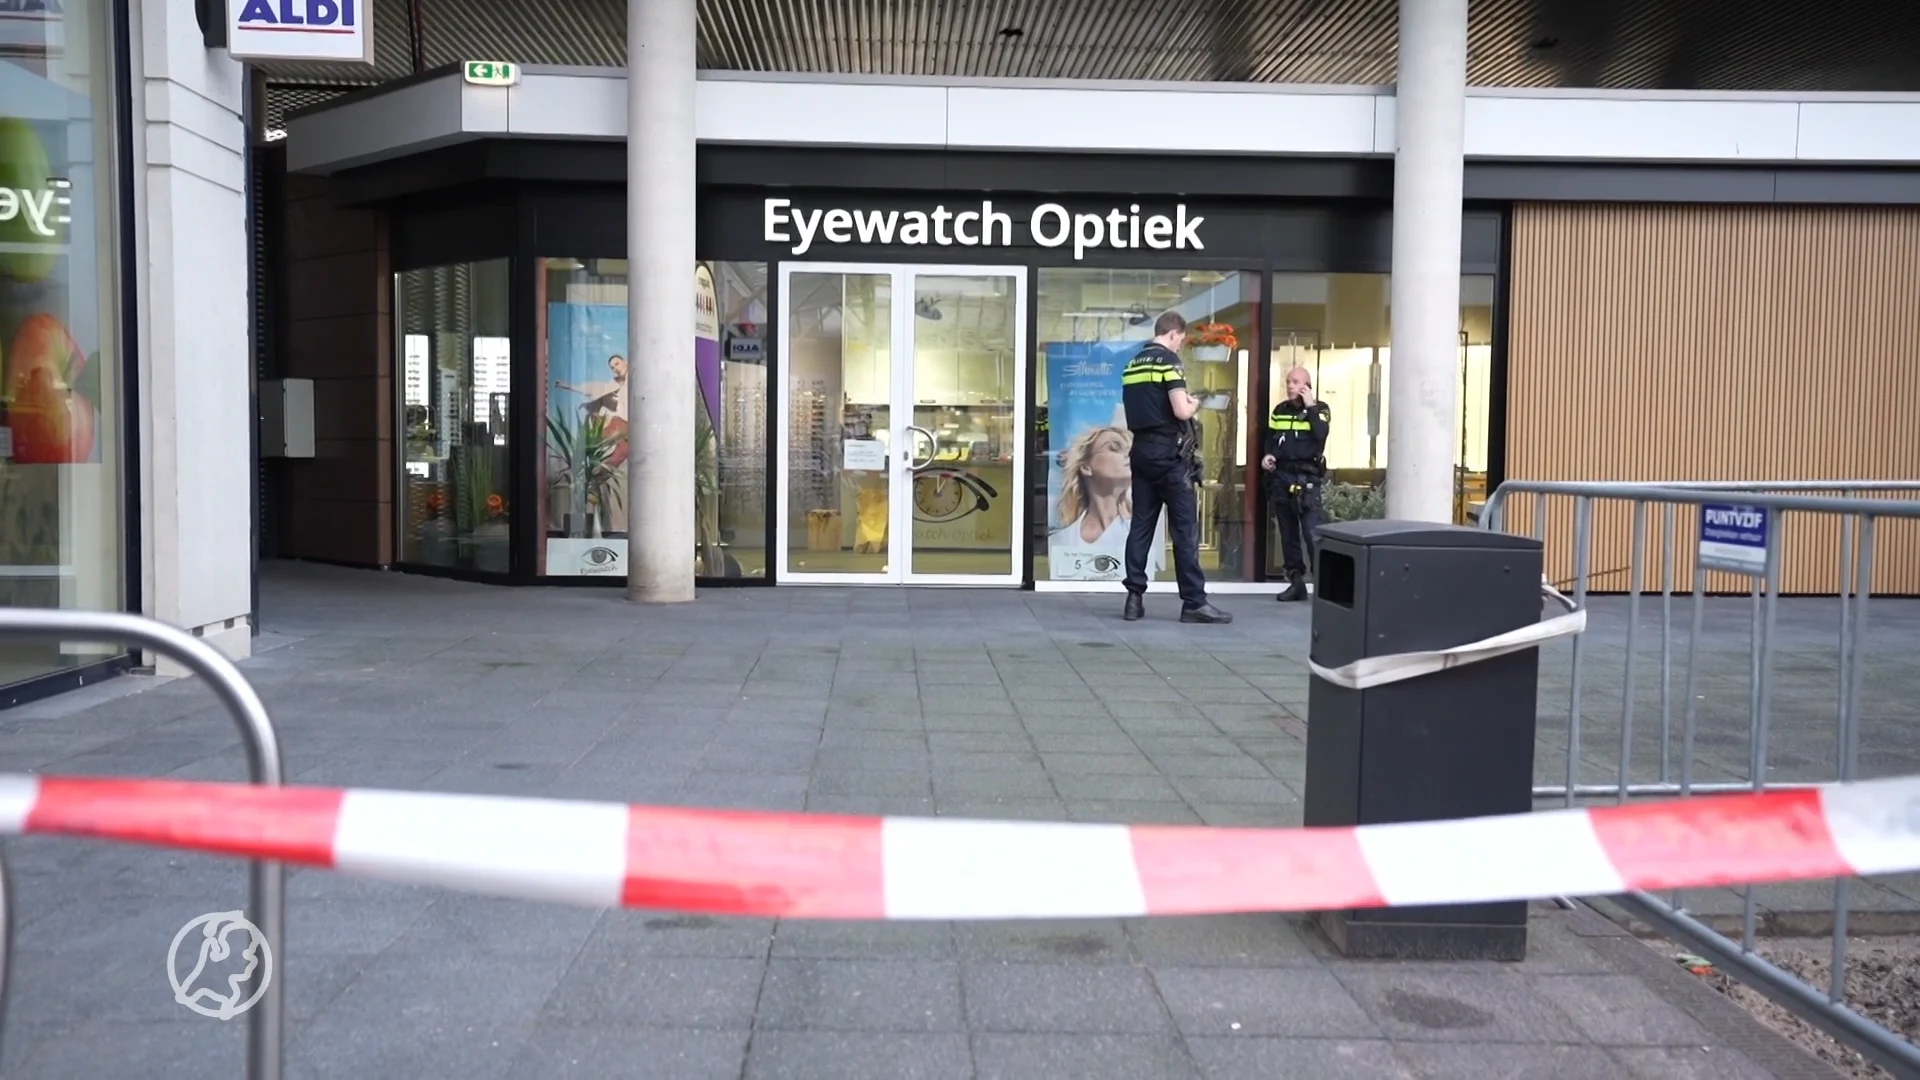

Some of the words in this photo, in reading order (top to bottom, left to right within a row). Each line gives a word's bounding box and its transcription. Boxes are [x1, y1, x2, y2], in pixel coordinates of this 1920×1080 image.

[238, 0, 355, 26] ALDI
[763, 198, 1012, 255] Eyewatch
[1030, 202, 1206, 260] Optiek
